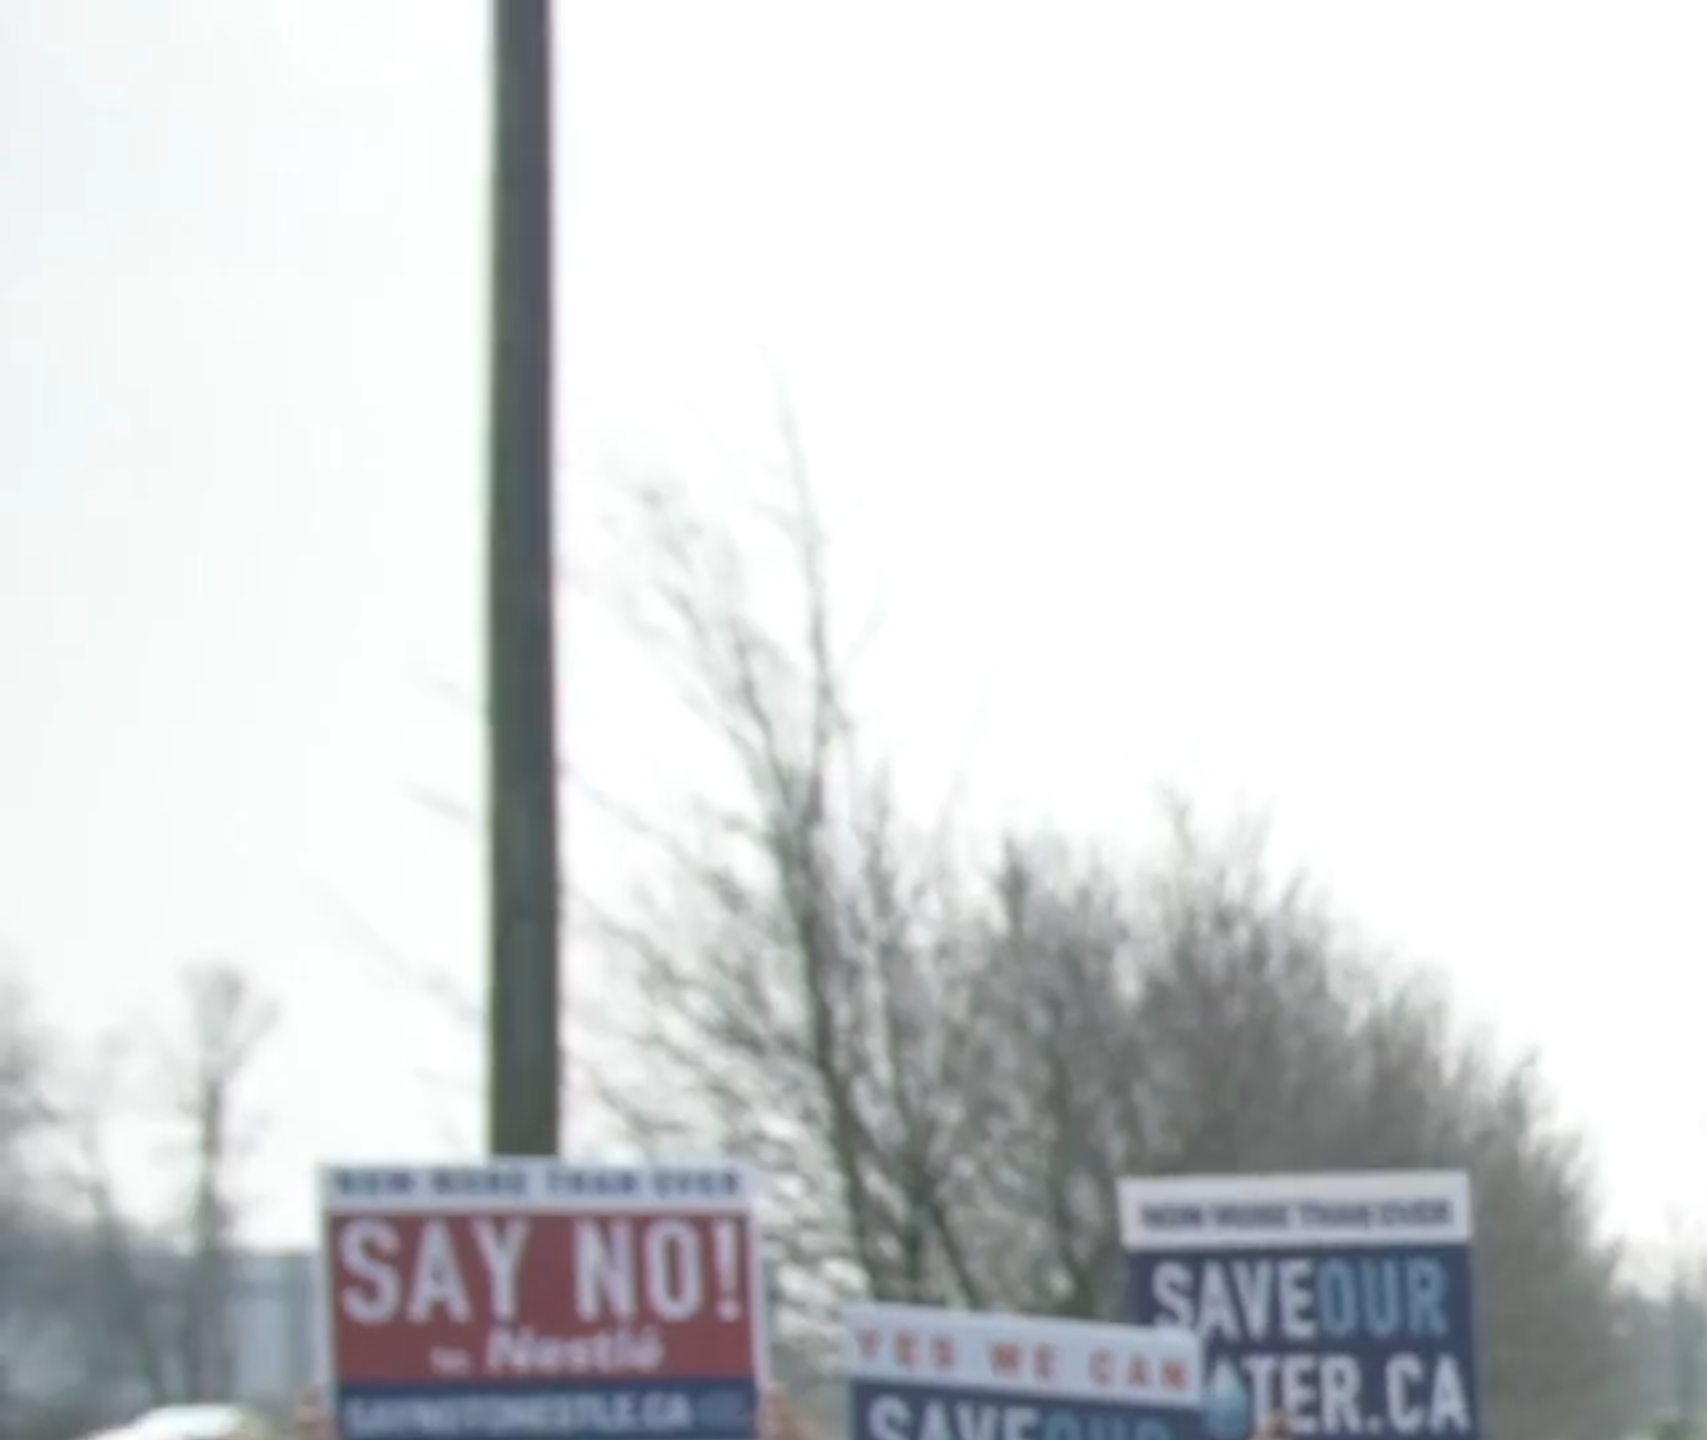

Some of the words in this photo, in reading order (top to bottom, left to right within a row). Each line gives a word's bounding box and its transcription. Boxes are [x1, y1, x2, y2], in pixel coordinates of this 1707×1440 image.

[340, 1216, 530, 1324] SAY
[573, 1217, 741, 1323] NO!
[487, 1324, 664, 1374] Nestlé
[857, 1328, 954, 1372] YES
[988, 1340, 1056, 1379] WE
[1089, 1346, 1187, 1390] CAN
